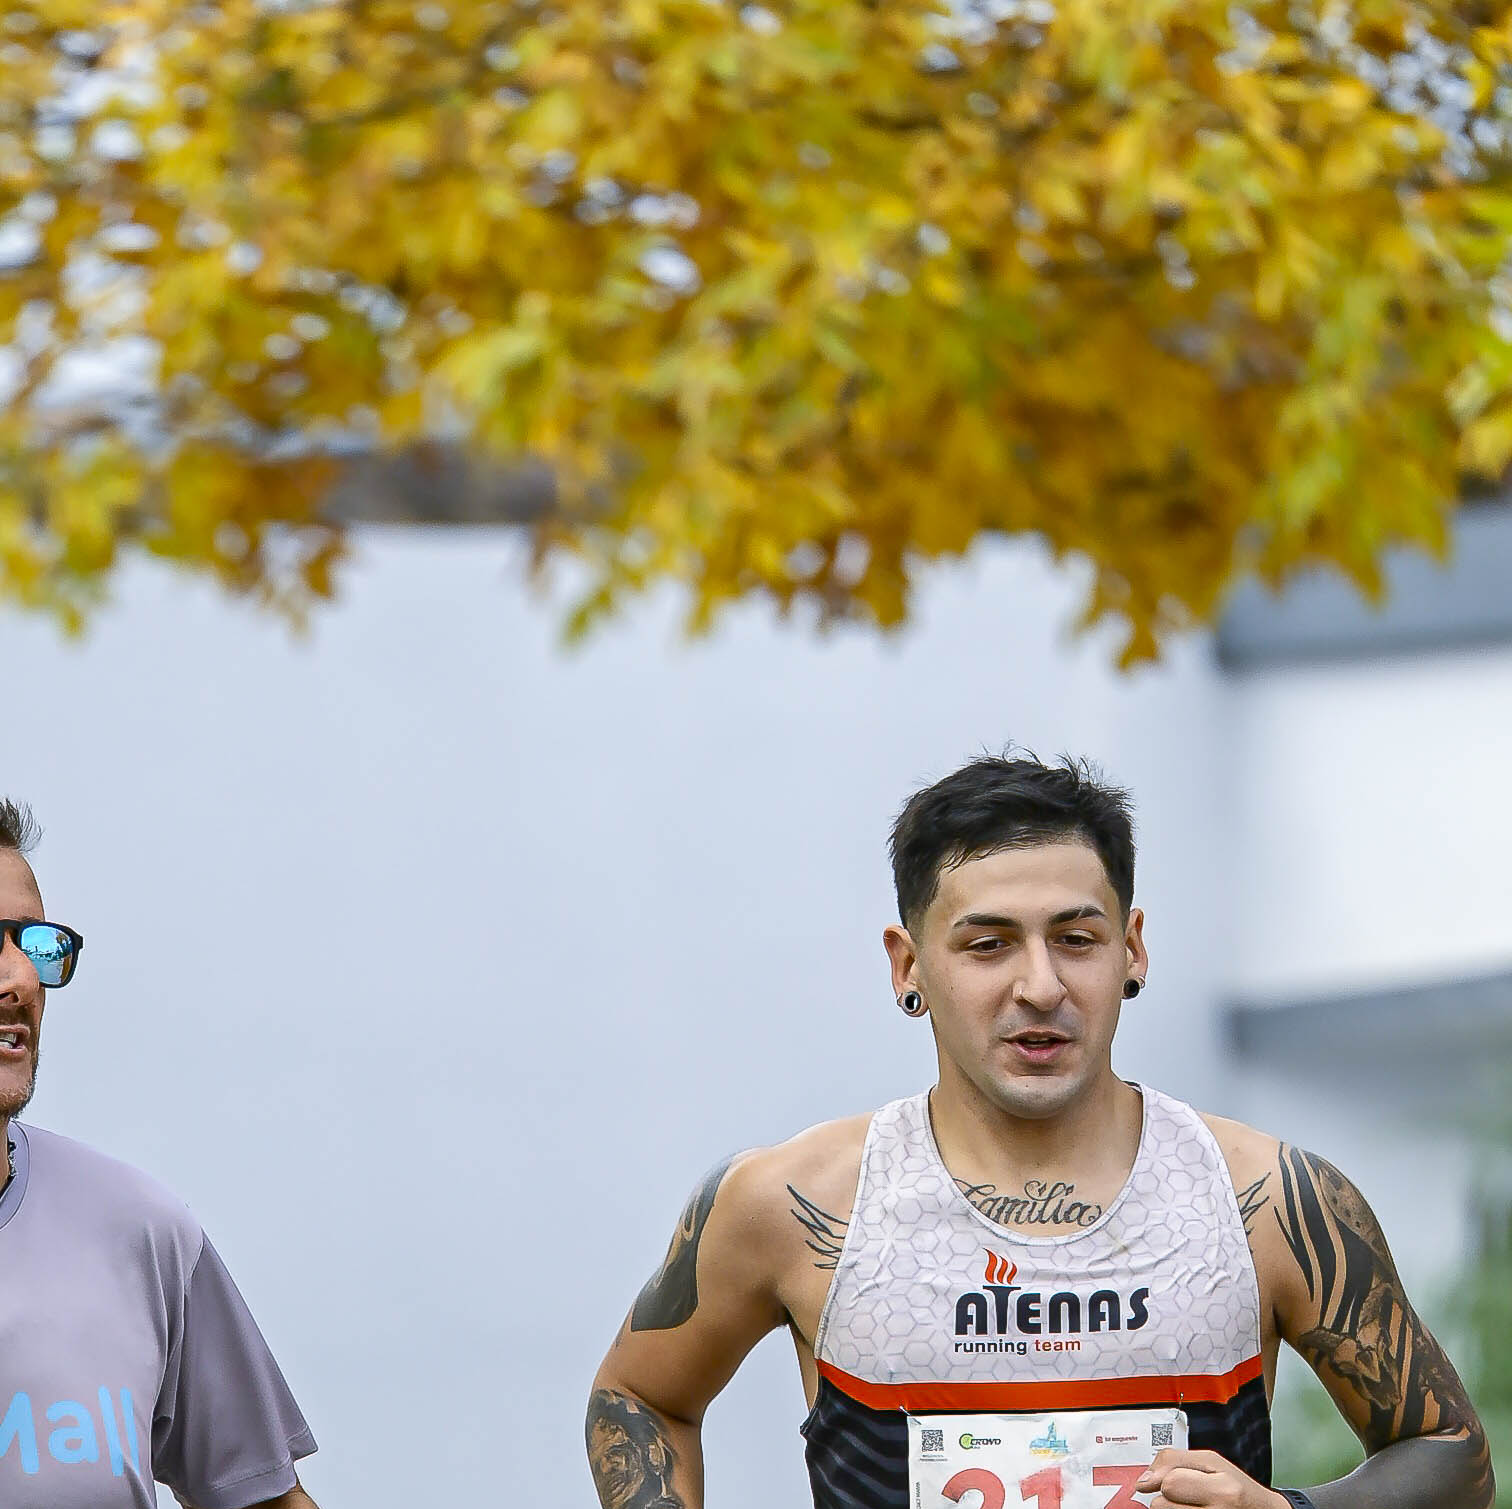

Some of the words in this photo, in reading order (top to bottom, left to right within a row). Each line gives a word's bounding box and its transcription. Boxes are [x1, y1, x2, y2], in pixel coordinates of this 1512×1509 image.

[954, 1285, 1150, 1336] ATENAS
[954, 1339, 1027, 1356] running
[1035, 1339, 1081, 1352] team
